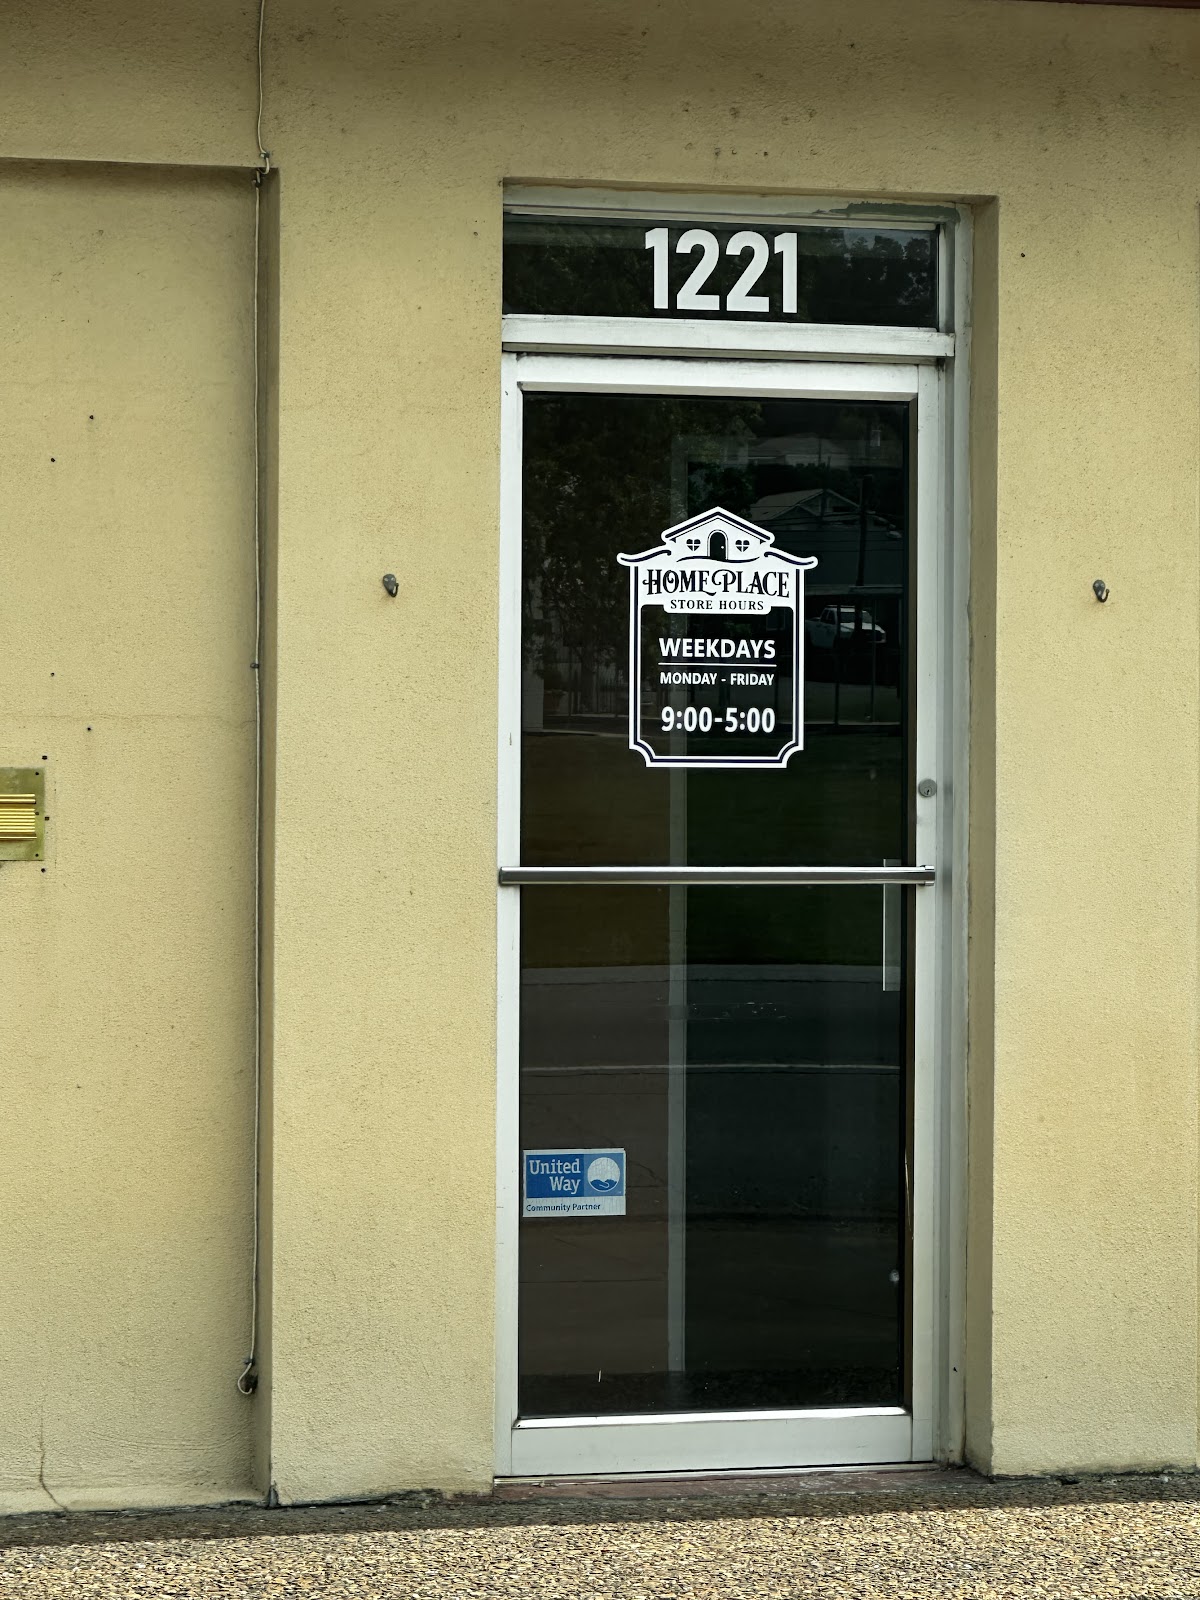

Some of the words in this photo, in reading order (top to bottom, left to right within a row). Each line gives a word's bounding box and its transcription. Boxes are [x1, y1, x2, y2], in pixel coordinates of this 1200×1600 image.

[645, 227, 798, 314] 1221
[670, 599, 713, 610] STORE
[719, 600, 764, 611] HOURS
[658, 637, 776, 659] WEEKDAYS
[660, 672, 717, 685] MONDAY
[730, 673, 775, 686] FRIDAY
[661, 706, 776, 733] 9:00-5:00
[529, 1158, 581, 1175] United
[549, 1176, 581, 1195] Way
[526, 1203, 571, 1213] Community
[572, 1203, 601, 1211] Partner
